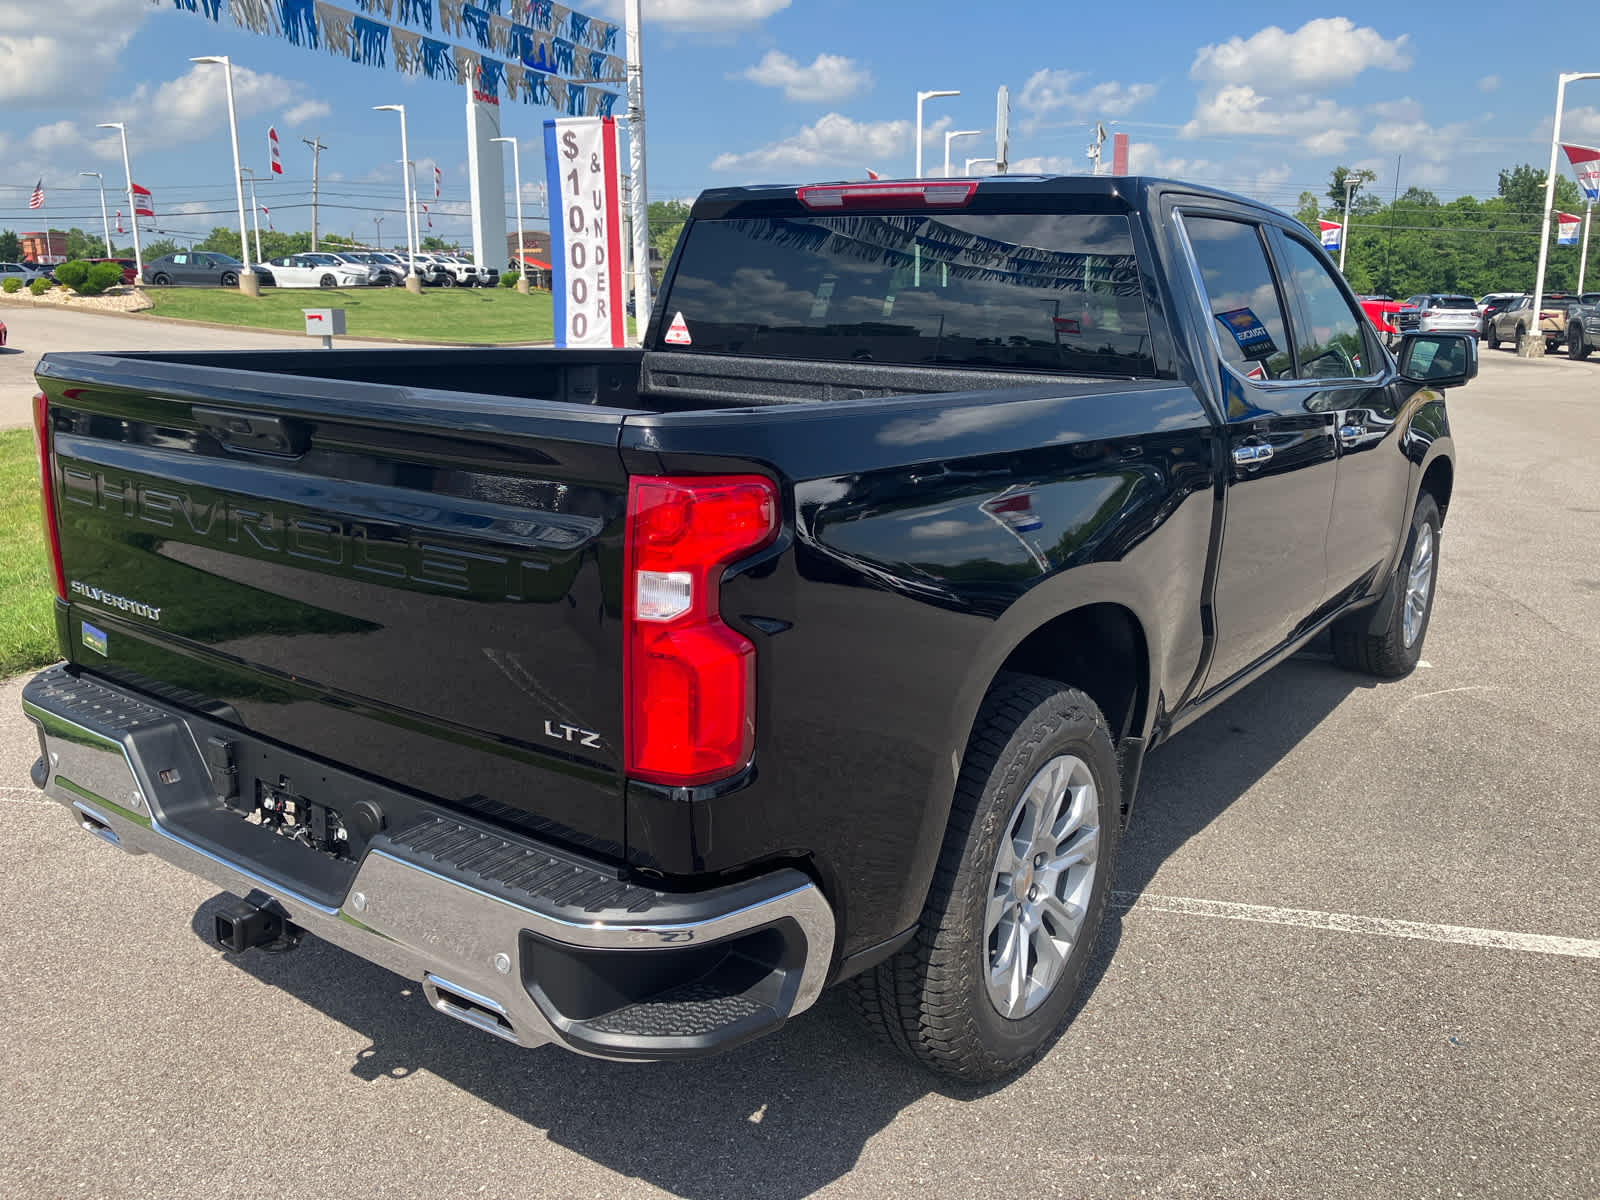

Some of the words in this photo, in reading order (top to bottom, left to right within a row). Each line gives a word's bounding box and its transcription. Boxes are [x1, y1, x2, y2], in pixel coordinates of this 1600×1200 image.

[590, 153, 601, 173] &
[562, 130, 589, 338] $10,000
[592, 190, 607, 318] UNDER
[62, 464, 551, 600] CHEVROLET
[71, 580, 160, 620] SILVERADO
[544, 719, 601, 748] LTZ
